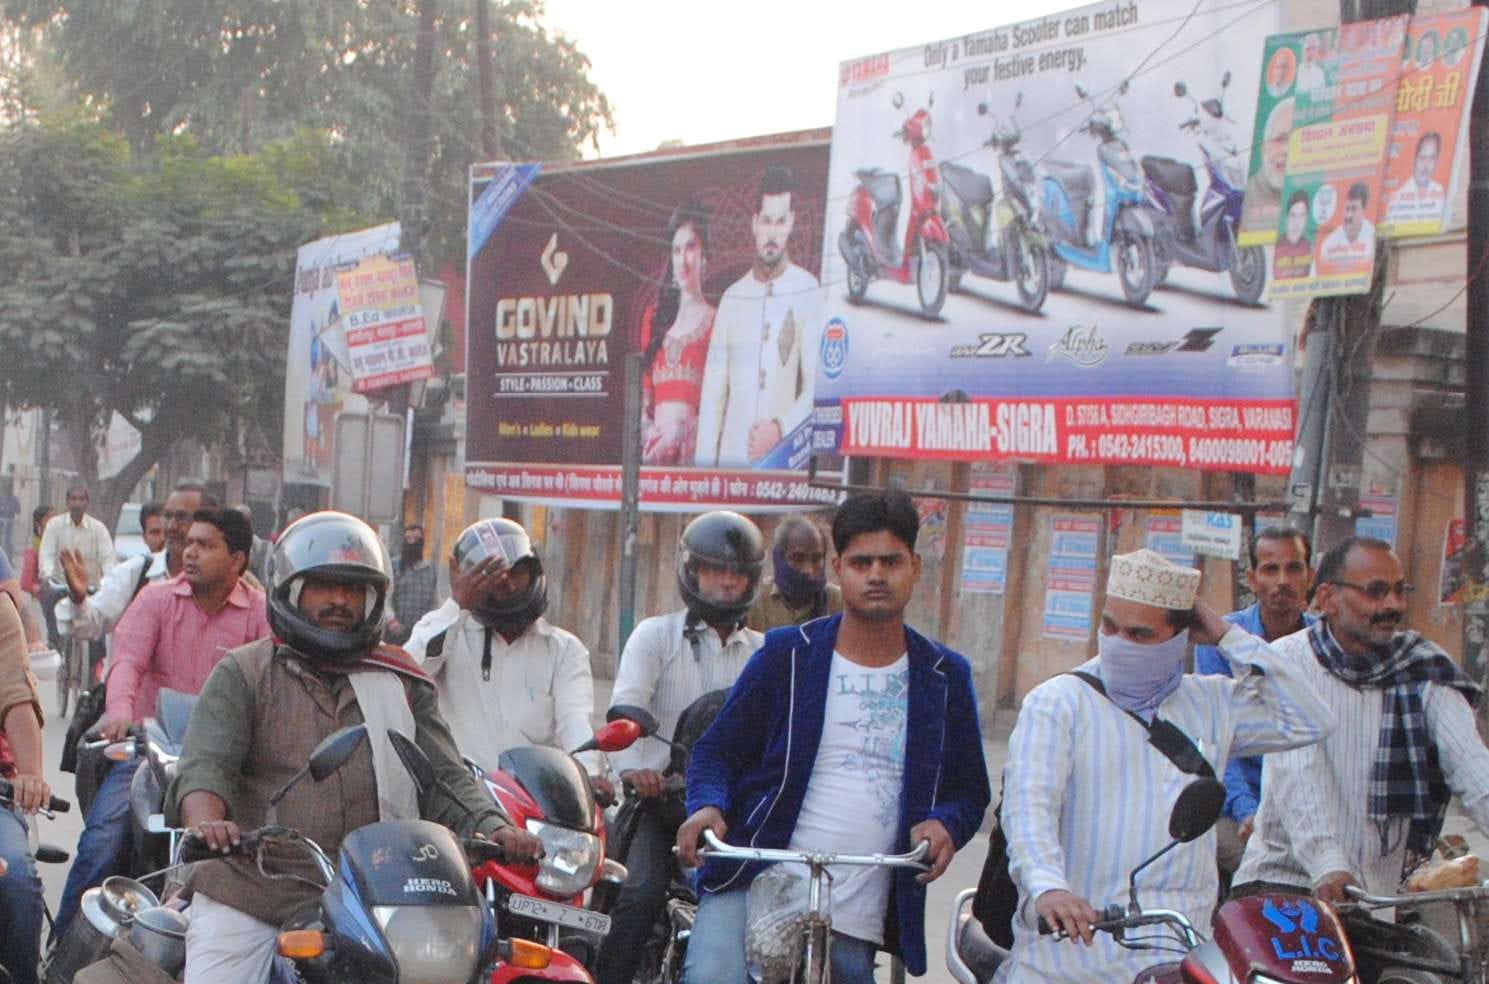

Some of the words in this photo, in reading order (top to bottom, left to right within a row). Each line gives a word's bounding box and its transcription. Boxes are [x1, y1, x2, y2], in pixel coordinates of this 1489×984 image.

[924, 45, 948, 69] Only
[952, 44, 959, 60] a
[962, 33, 1009, 57] Yamaha
[1012, 18, 1061, 46] Scooter
[1064, 17, 1089, 36] can
[1094, 4, 1138, 31] match
[963, 66, 990, 88] your
[993, 54, 1035, 81] festive
[1038, 47, 1088, 76] energy.
[496, 293, 613, 339] GOVIND
[497, 340, 608, 367] VASTRALAYA
[1053, 325, 1109, 354] Alpha
[500, 377, 524, 391] STYLE
[530, 377, 567, 391] PASSION
[574, 377, 602, 391] CLASS
[529, 422, 553, 437] Ladies
[580, 426, 601, 437] wear
[848, 401, 912, 448] YUVRAJ
[915, 402, 1058, 454] YAMAHA-SIGRA
[403, 884, 458, 897] HONDA
[407, 878, 452, 887] HERO
